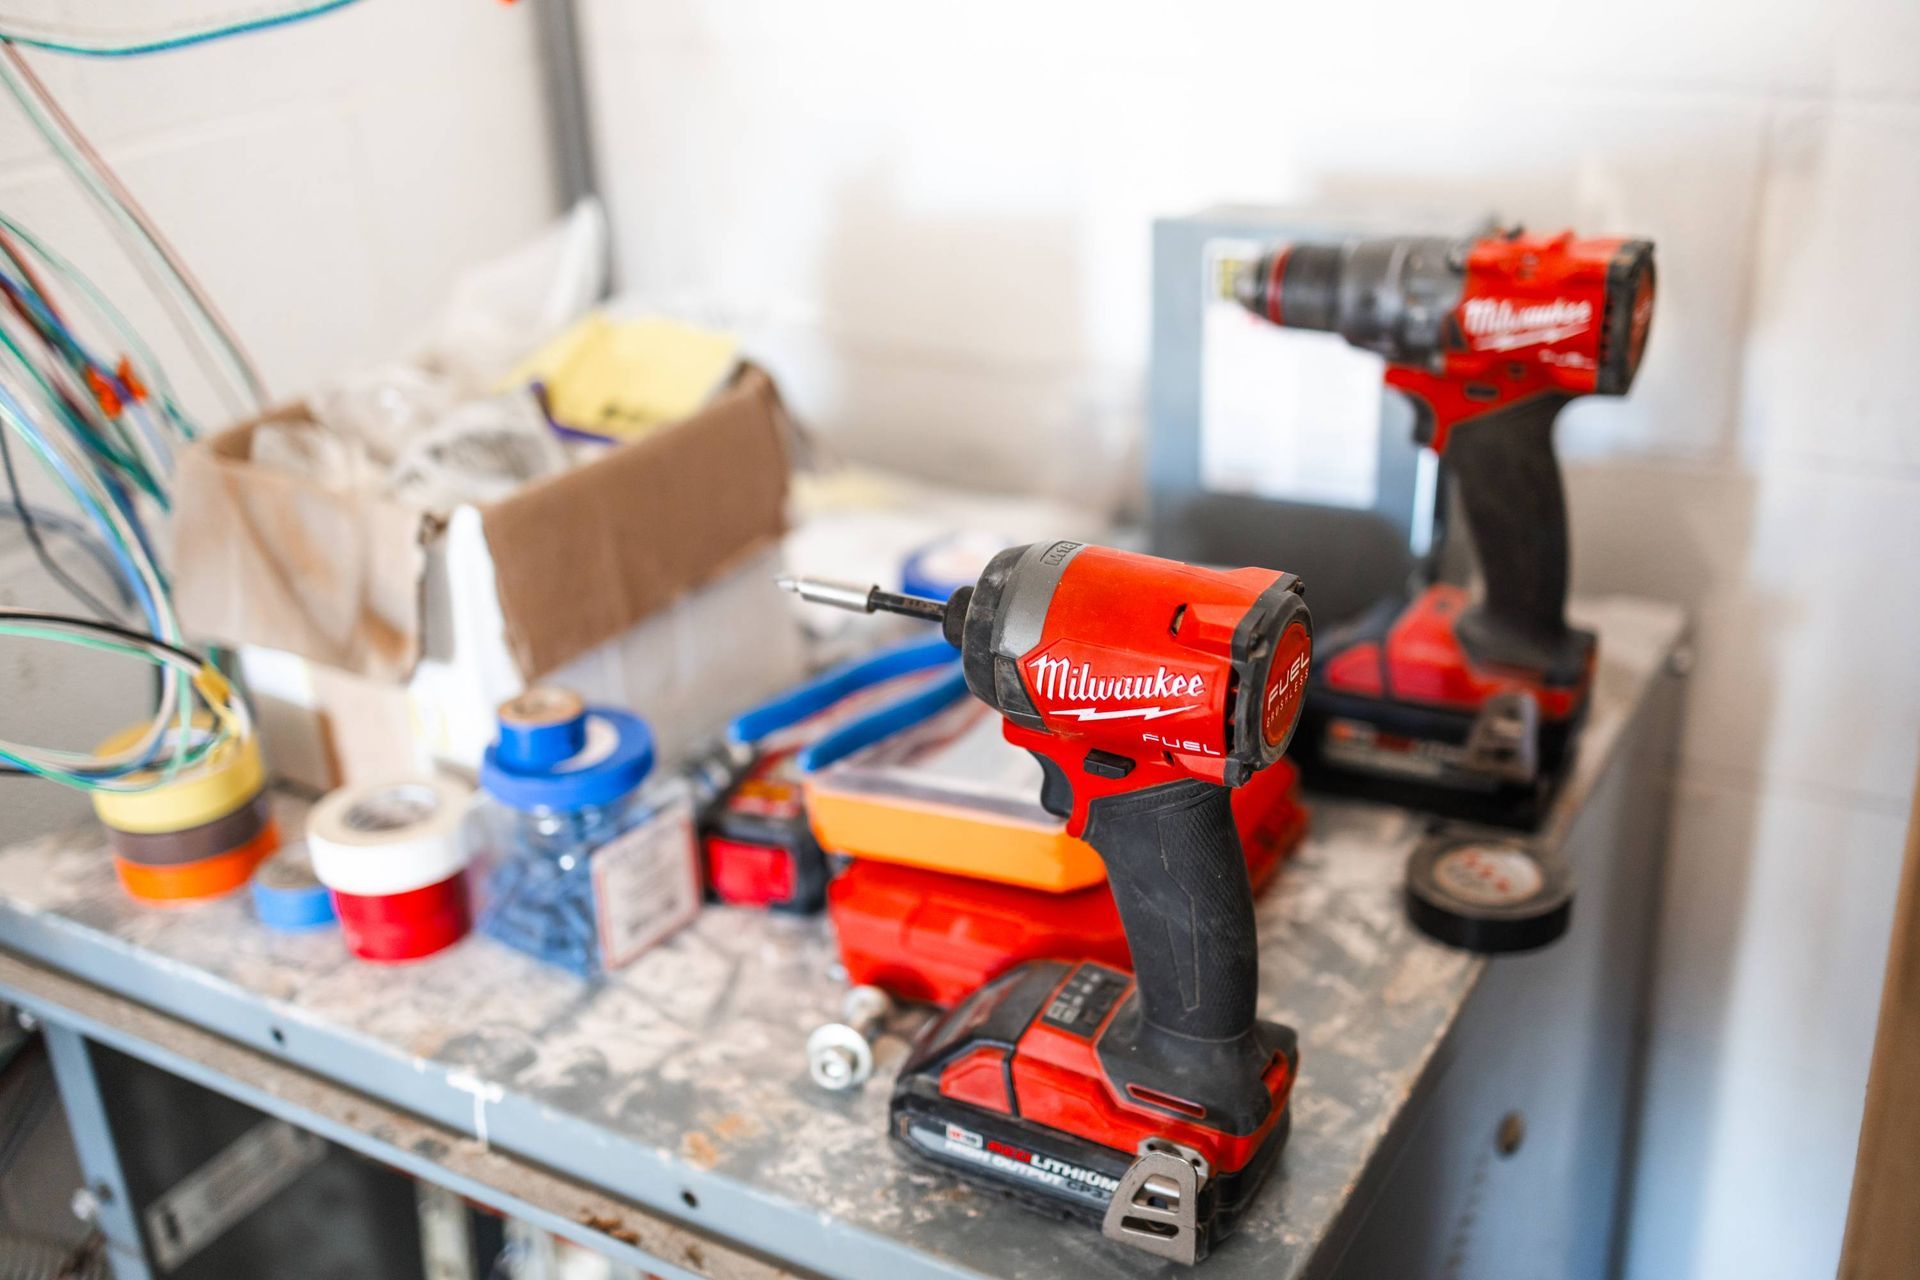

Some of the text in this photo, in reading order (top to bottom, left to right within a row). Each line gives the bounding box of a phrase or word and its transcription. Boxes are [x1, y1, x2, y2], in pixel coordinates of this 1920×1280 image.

[1028, 652, 1205, 701] Milwaukee
[1266, 668, 1309, 728] BRUSHLESS
[1267, 651, 1310, 711] FUEL
[1142, 732, 1221, 755] FUEL
[991, 1154, 1063, 1186] OUTPUT
